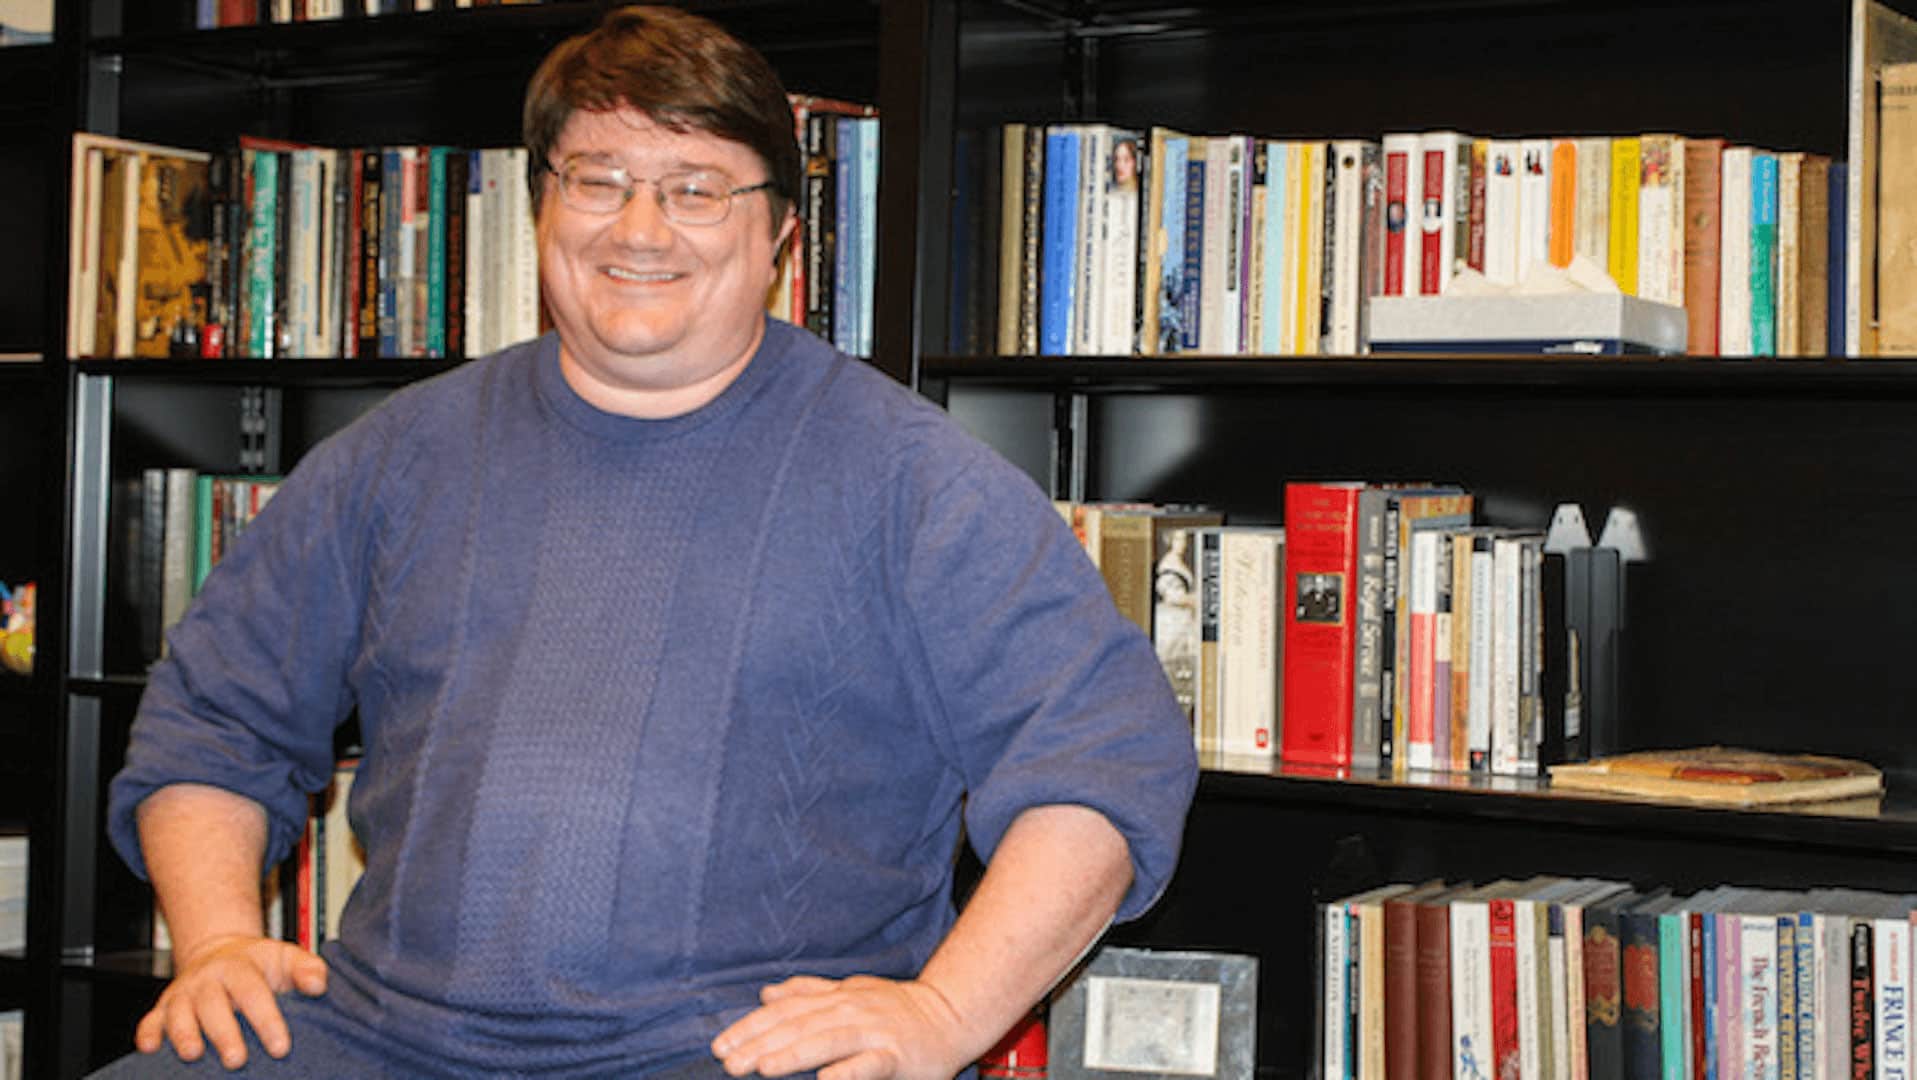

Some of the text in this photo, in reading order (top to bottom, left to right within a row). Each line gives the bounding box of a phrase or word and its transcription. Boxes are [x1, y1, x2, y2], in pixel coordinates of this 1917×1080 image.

[1752, 957, 1770, 979] The
[1752, 985, 1770, 1040] French
[1853, 977, 1871, 1038] Twelve
[1883, 985, 1905, 1061] FRANCE
